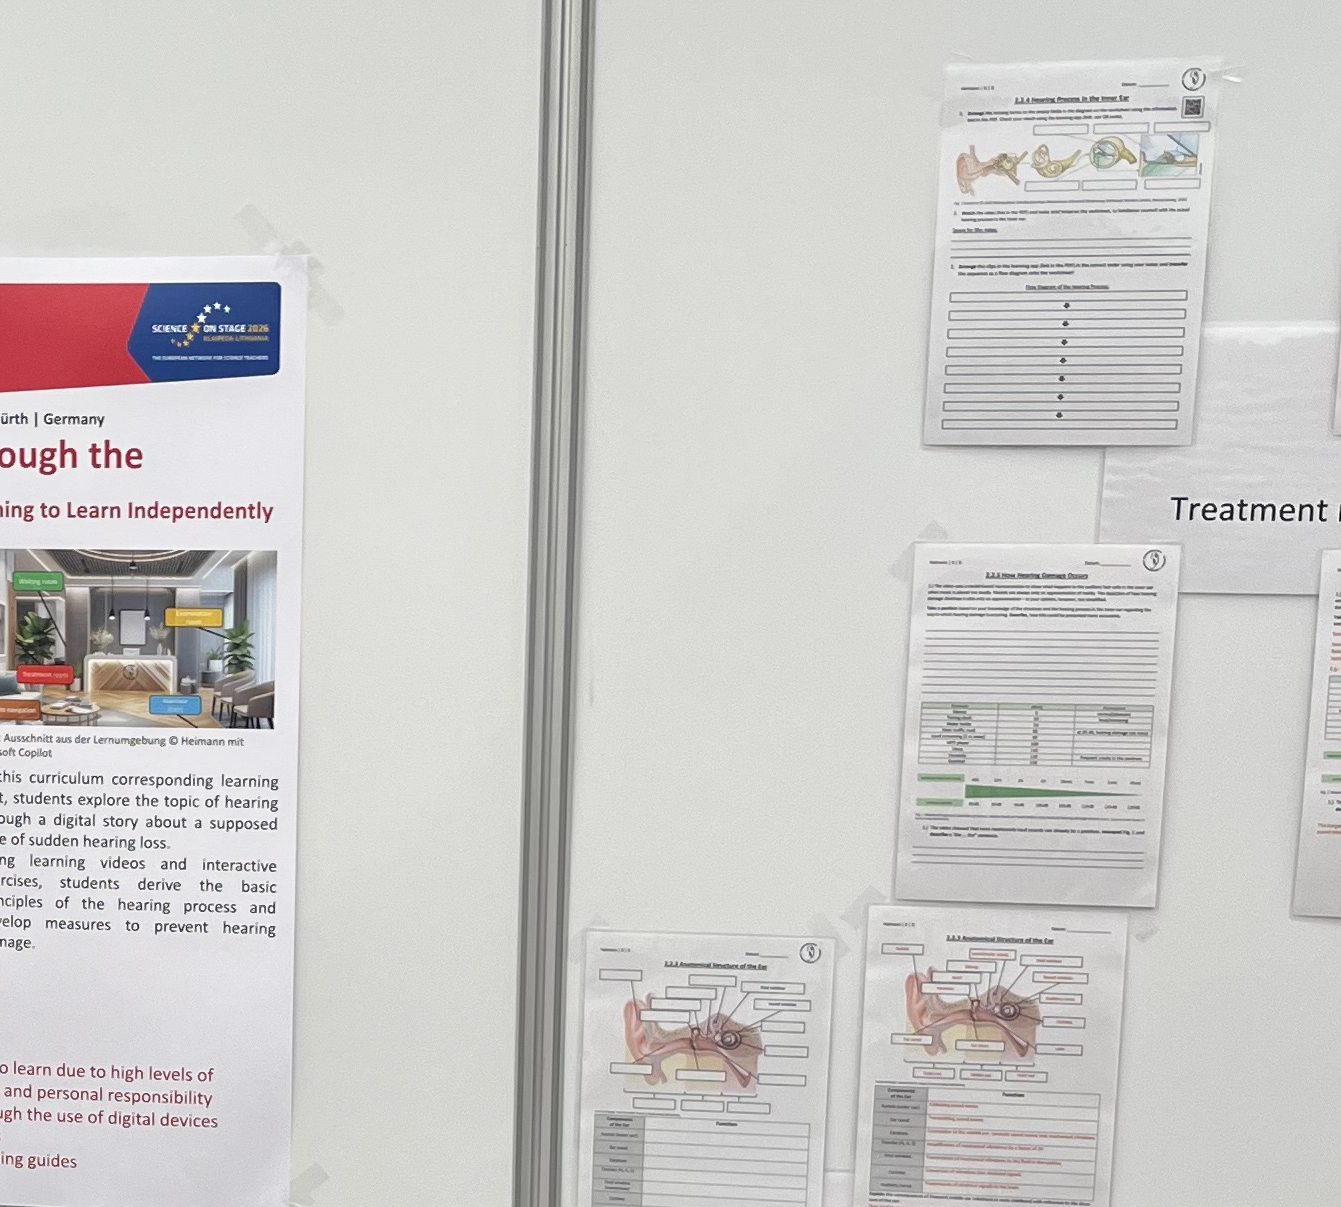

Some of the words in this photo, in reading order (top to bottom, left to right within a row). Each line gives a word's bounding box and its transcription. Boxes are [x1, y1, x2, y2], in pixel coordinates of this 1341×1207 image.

[152, 324, 188, 333] SCIENCE
[203, 324, 216, 333] ON
[218, 324, 246, 333] STAGE
[43, 413, 105, 428] Germany
[88, 439, 143, 469] the
[40, 502, 60, 518] to
[67, 502, 121, 518] Learn
[128, 501, 274, 524] Independently
[1171, 497, 1328, 522] Treatment
[3, 733, 53, 744] Ausschnitt
[55, 736, 73, 744] aus
[74, 734, 91, 744] der
[93, 736, 166, 747] Lernumgebung
[181, 736, 225, 746] Heimann
[227, 737, 245, 746] mit
[18, 748, 53, 759] Copilot
[29, 771, 104, 785] curriculum
[111, 773, 213, 790] corresponding
[221, 774, 279, 791] learning
[13, 792, 73, 806] students
[78, 793, 130, 808] explore
[135, 794, 159, 807] the
[164, 795, 199, 810] topic
[205, 794, 220, 808] of
[225, 795, 279, 812] hearing
[38, 816, 46, 826] a
[53, 813, 95, 830] digital
[103, 816, 139, 830] story
[145, 815, 187, 828] about
[194, 819, 202, 829] a
[210, 817, 277, 832] supposed
[13, 1060, 51, 1076] learn
[57, 1062, 85, 1078] due
[90, 1066, 106, 1078] to
[111, 1065, 143, 1083] high
[149, 1066, 193, 1082] levels
[197, 1068, 214, 1082] of
[4, 1084, 32, 1098] and
[37, 1087, 103, 1102] personal
[108, 1090, 213, 1108] responsibility
[27, 1107, 52, 1122] the
[57, 1112, 83, 1123] use
[87, 1110, 104, 1124] of
[108, 1111, 155, 1128] digital
[160, 1112, 218, 1128] devices
[27, 1154, 77, 1170] guides
